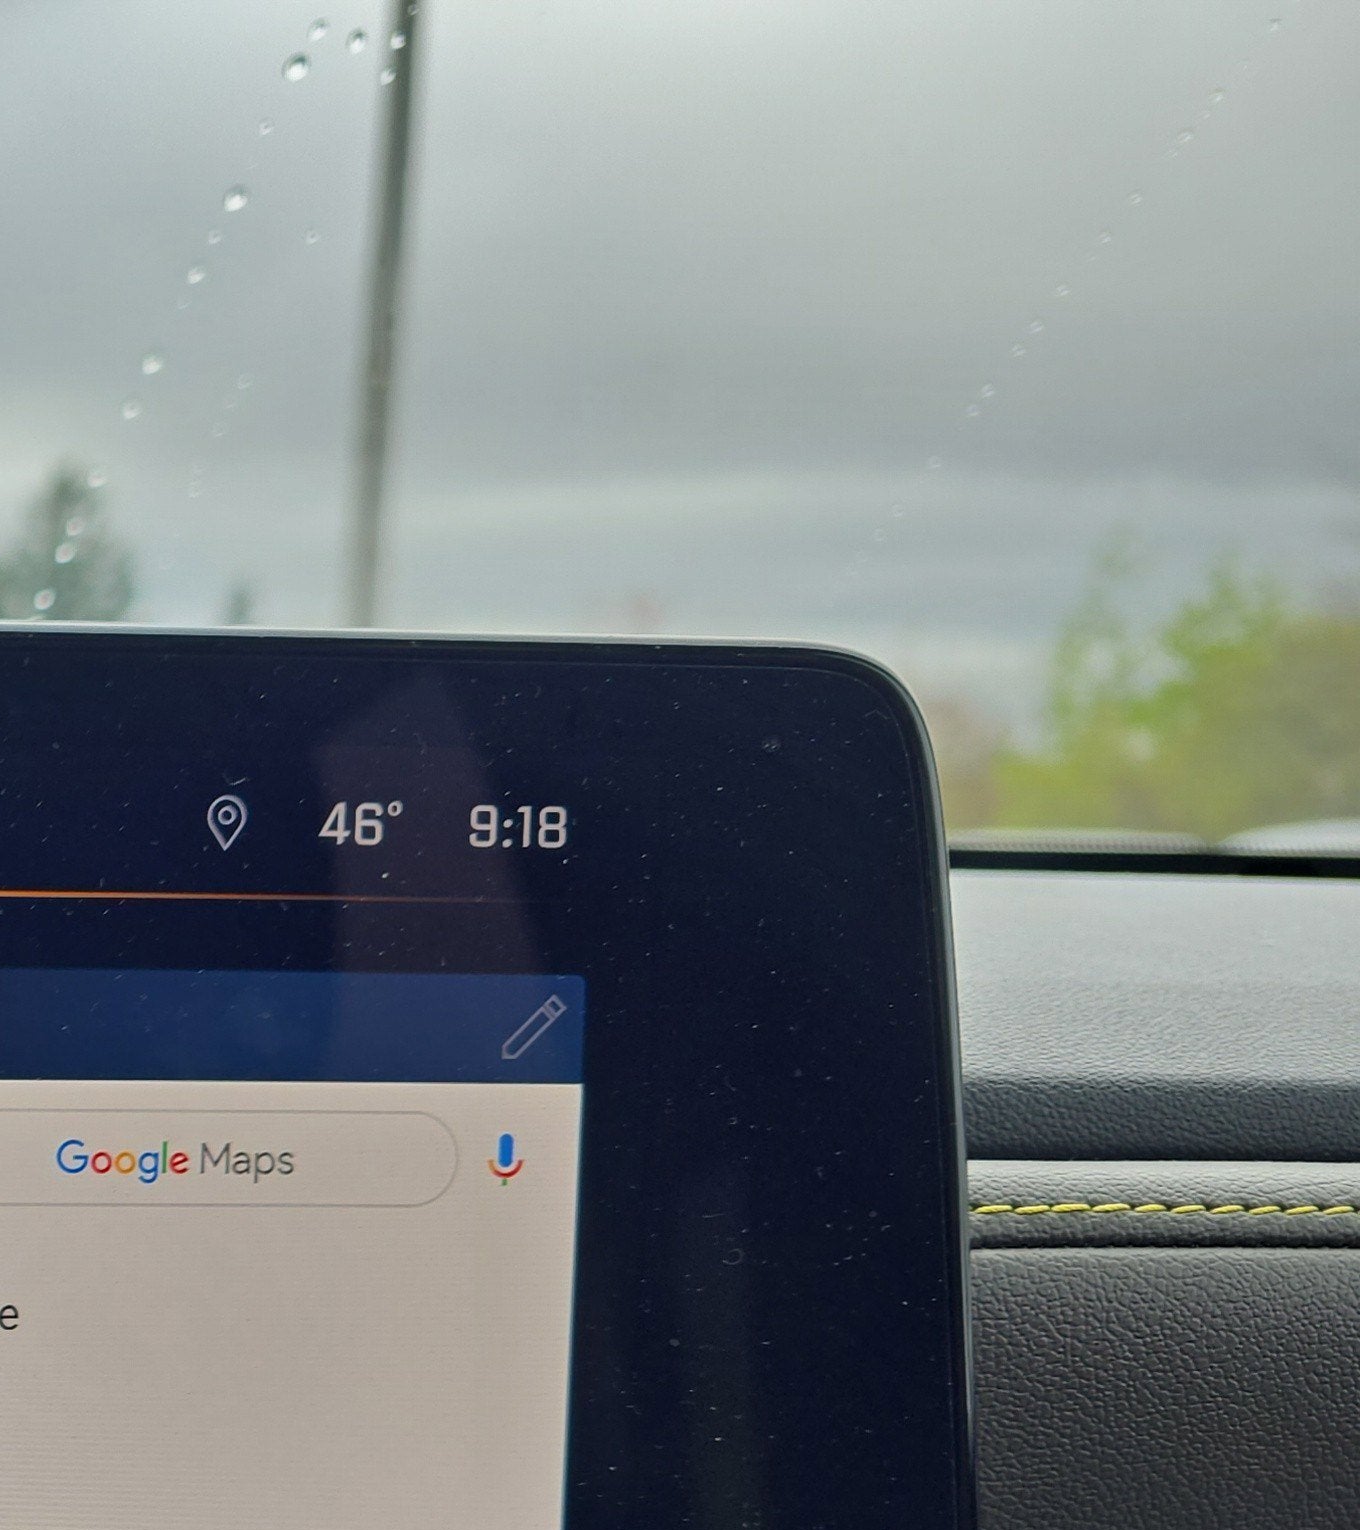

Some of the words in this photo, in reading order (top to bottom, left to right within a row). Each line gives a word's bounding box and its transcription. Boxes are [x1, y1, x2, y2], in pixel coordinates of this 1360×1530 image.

[318, 800, 404, 846] 46°
[469, 804, 568, 848] 9:18
[55, 1138, 190, 1183] Google
[199, 1142, 295, 1183] Maps
